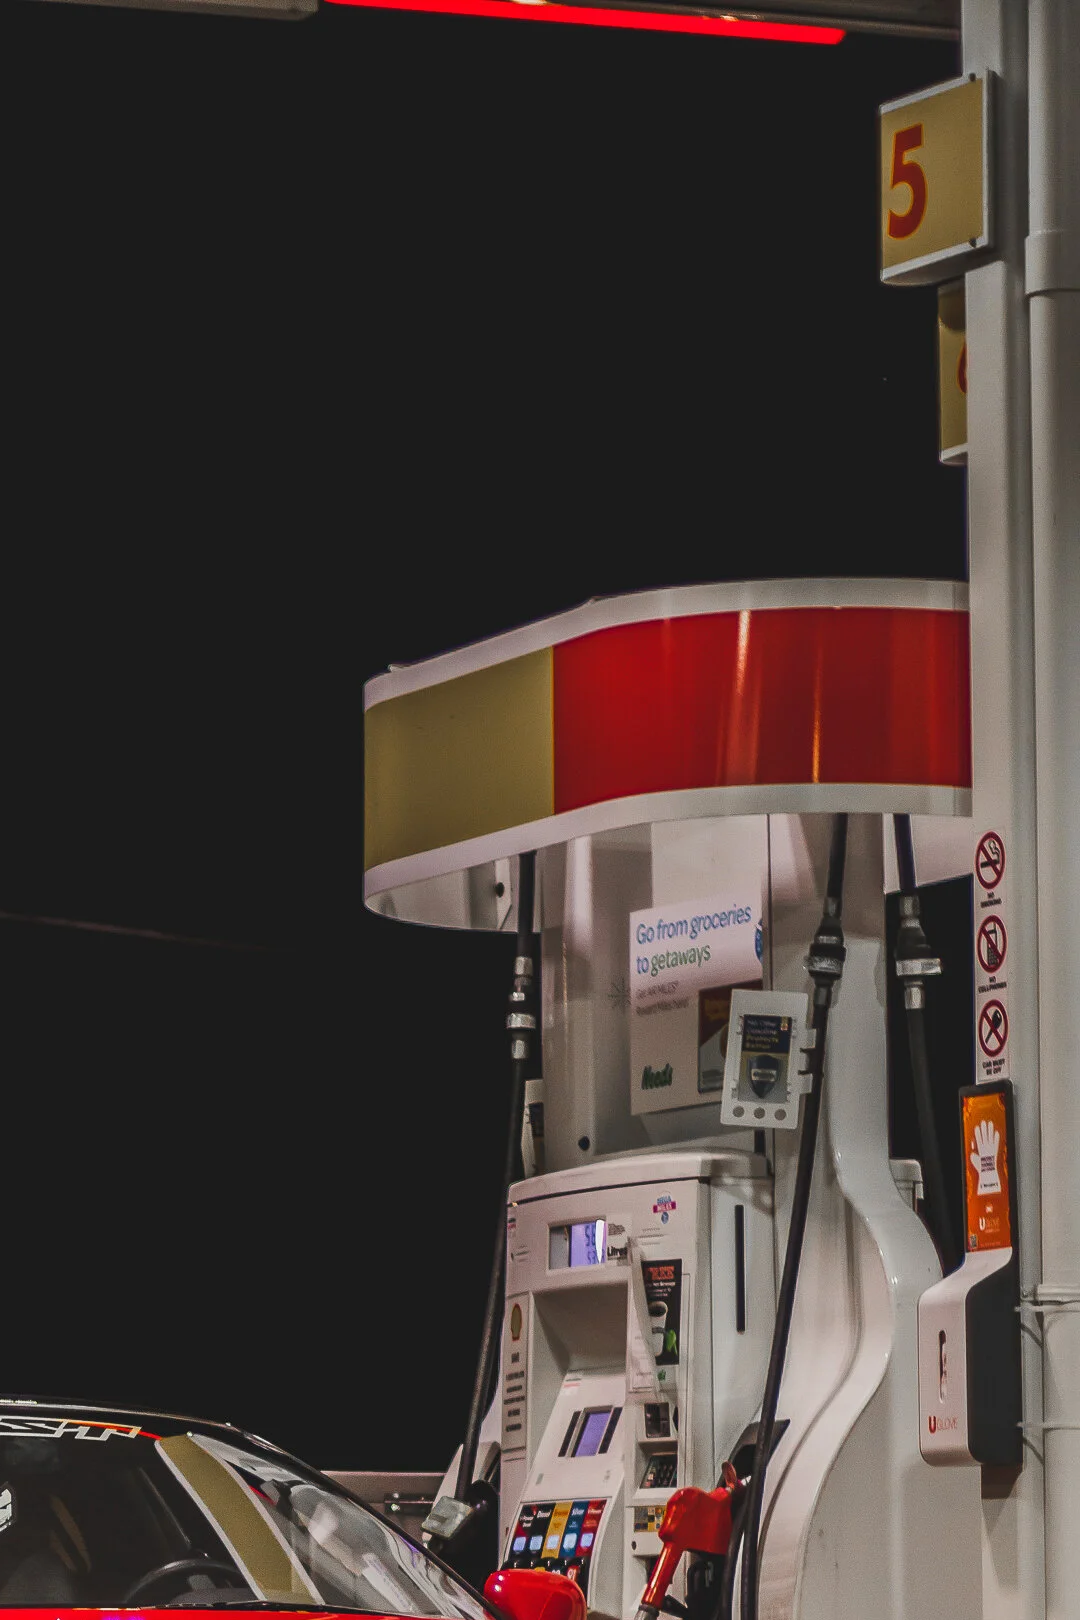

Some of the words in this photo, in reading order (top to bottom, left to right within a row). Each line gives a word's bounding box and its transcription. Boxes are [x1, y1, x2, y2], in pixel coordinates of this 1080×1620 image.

[888, 123, 928, 240] 5
[636, 923, 655, 945] Go
[657, 919, 689, 941] from
[689, 904, 752, 940] groceries
[636, 955, 650, 975] to
[650, 945, 712, 977] getaways
